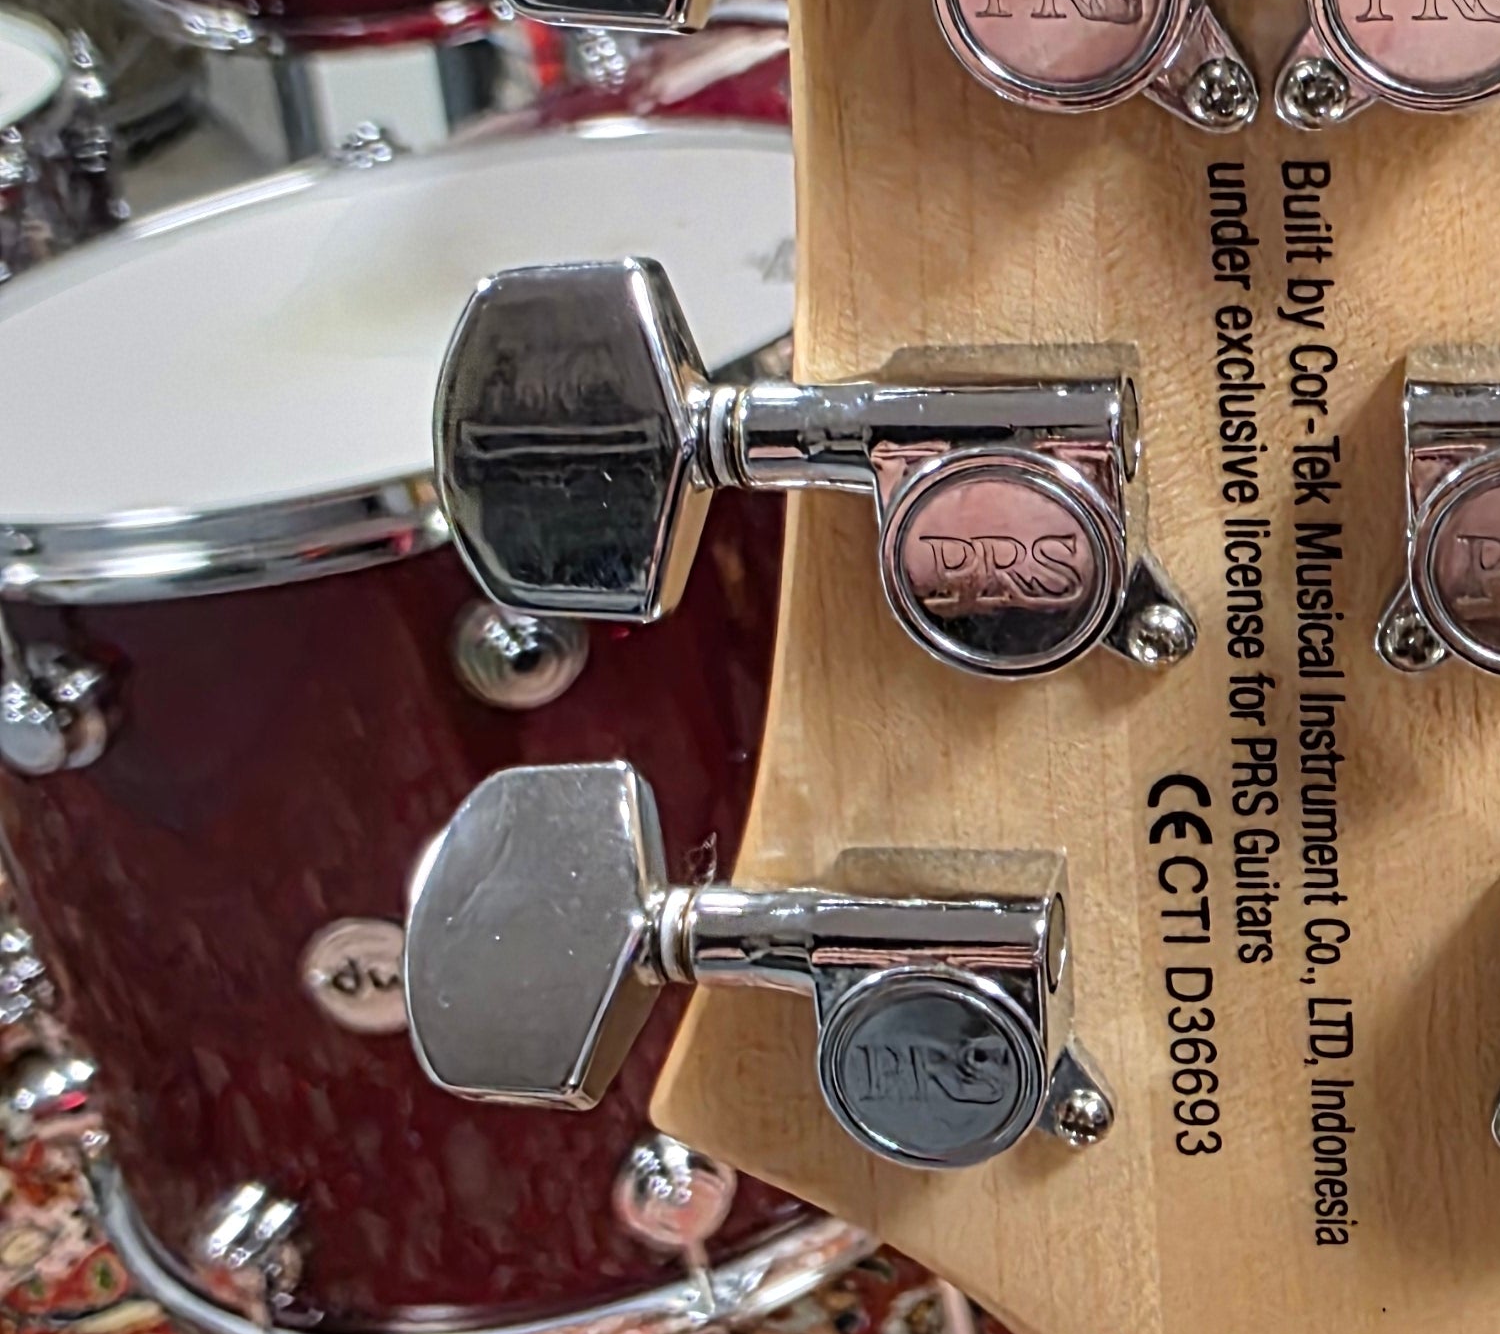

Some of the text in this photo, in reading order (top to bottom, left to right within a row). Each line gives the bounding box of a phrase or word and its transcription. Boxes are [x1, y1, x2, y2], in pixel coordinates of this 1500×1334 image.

[1279, 158, 1334, 265] Built
[1276, 274, 1335, 330] by
[1288, 343, 1343, 507] Cor-Tek
[918, 533, 1084, 603] PRS
[1206, 160, 1282, 964] under exclusive license for PRS Guitars
[1293, 514, 1346, 679] Musical
[1298, 689, 1348, 906] Instrument
[1157, 854, 1211, 944] CTI
[1299, 917, 1351, 985] Co.,
[855, 1036, 1011, 1105] PRS
[1164, 965, 1223, 1156] D36693
[1310, 1078, 1359, 1246] Indonesia
